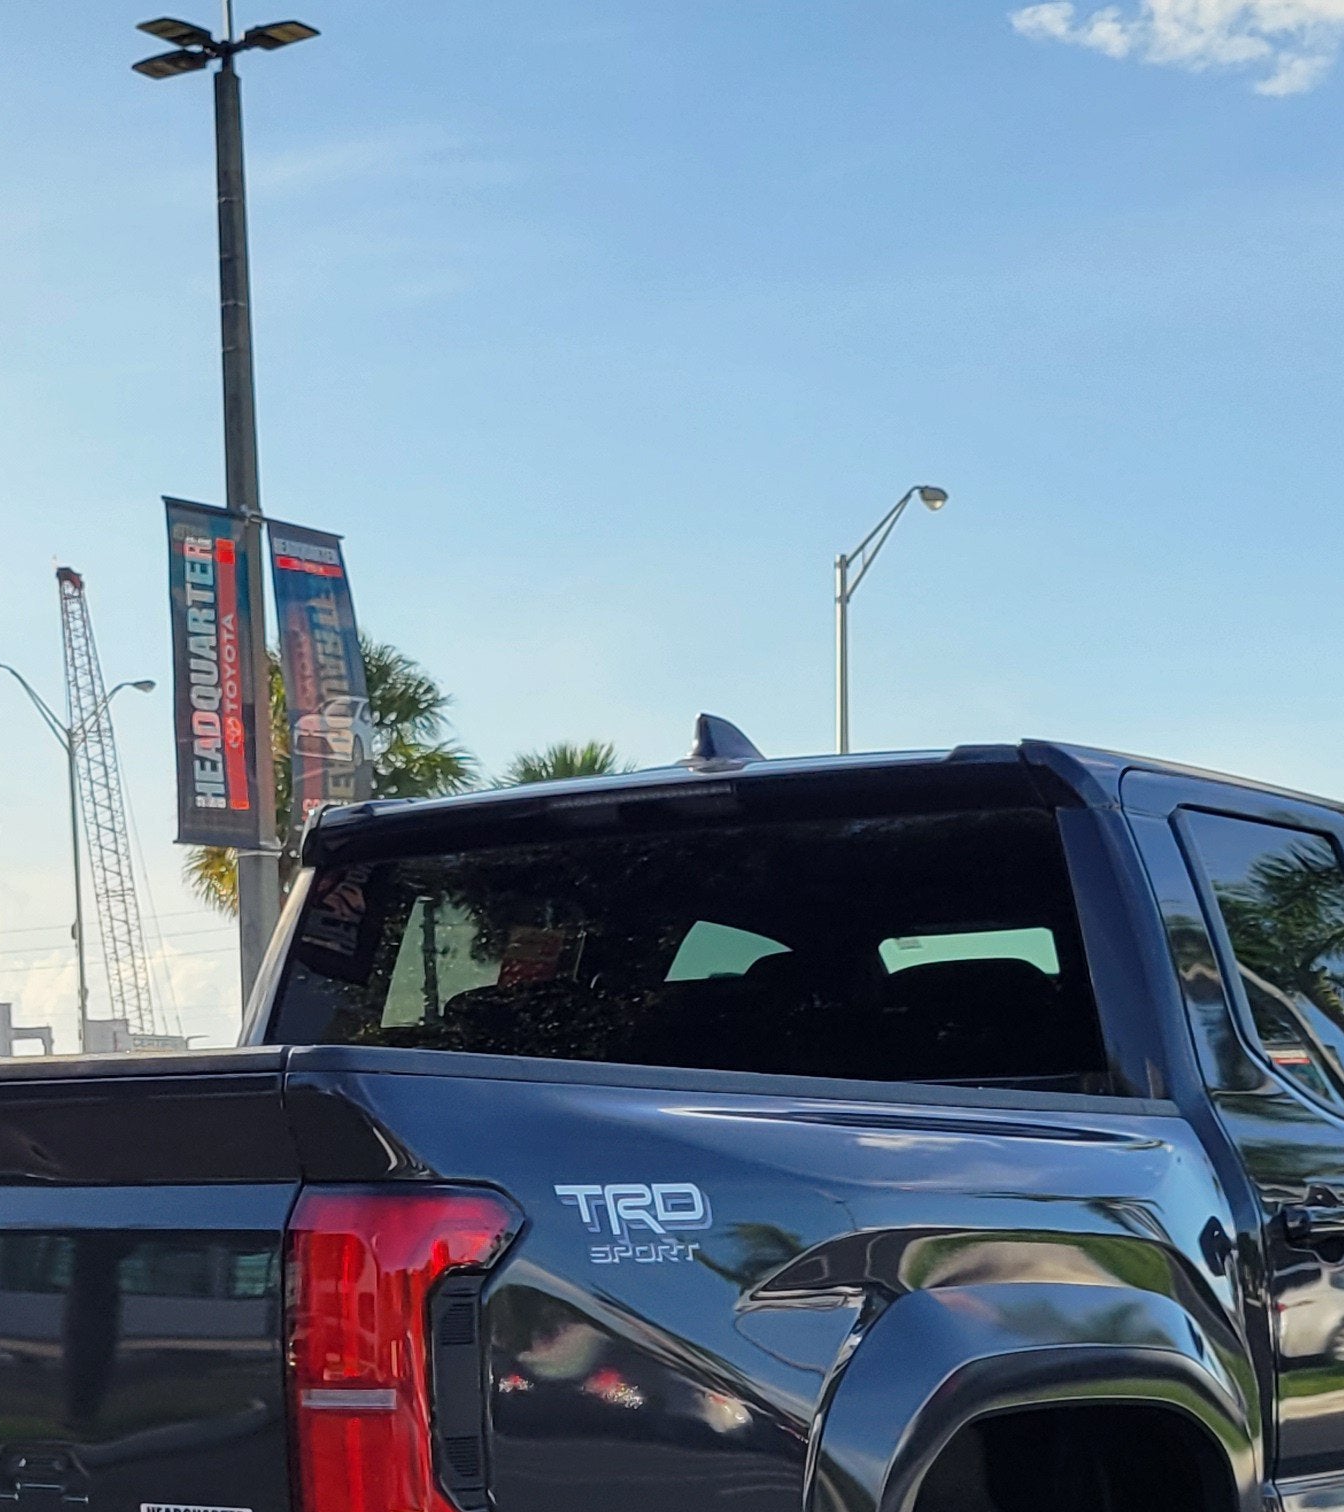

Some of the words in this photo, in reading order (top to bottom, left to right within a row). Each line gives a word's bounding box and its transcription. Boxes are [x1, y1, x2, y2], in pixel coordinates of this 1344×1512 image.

[183, 536, 227, 809] HEADQUARTER
[220, 613, 239, 712] TOYOTA
[554, 1183, 712, 1243] TRD
[590, 1243, 700, 1264] SPORT
